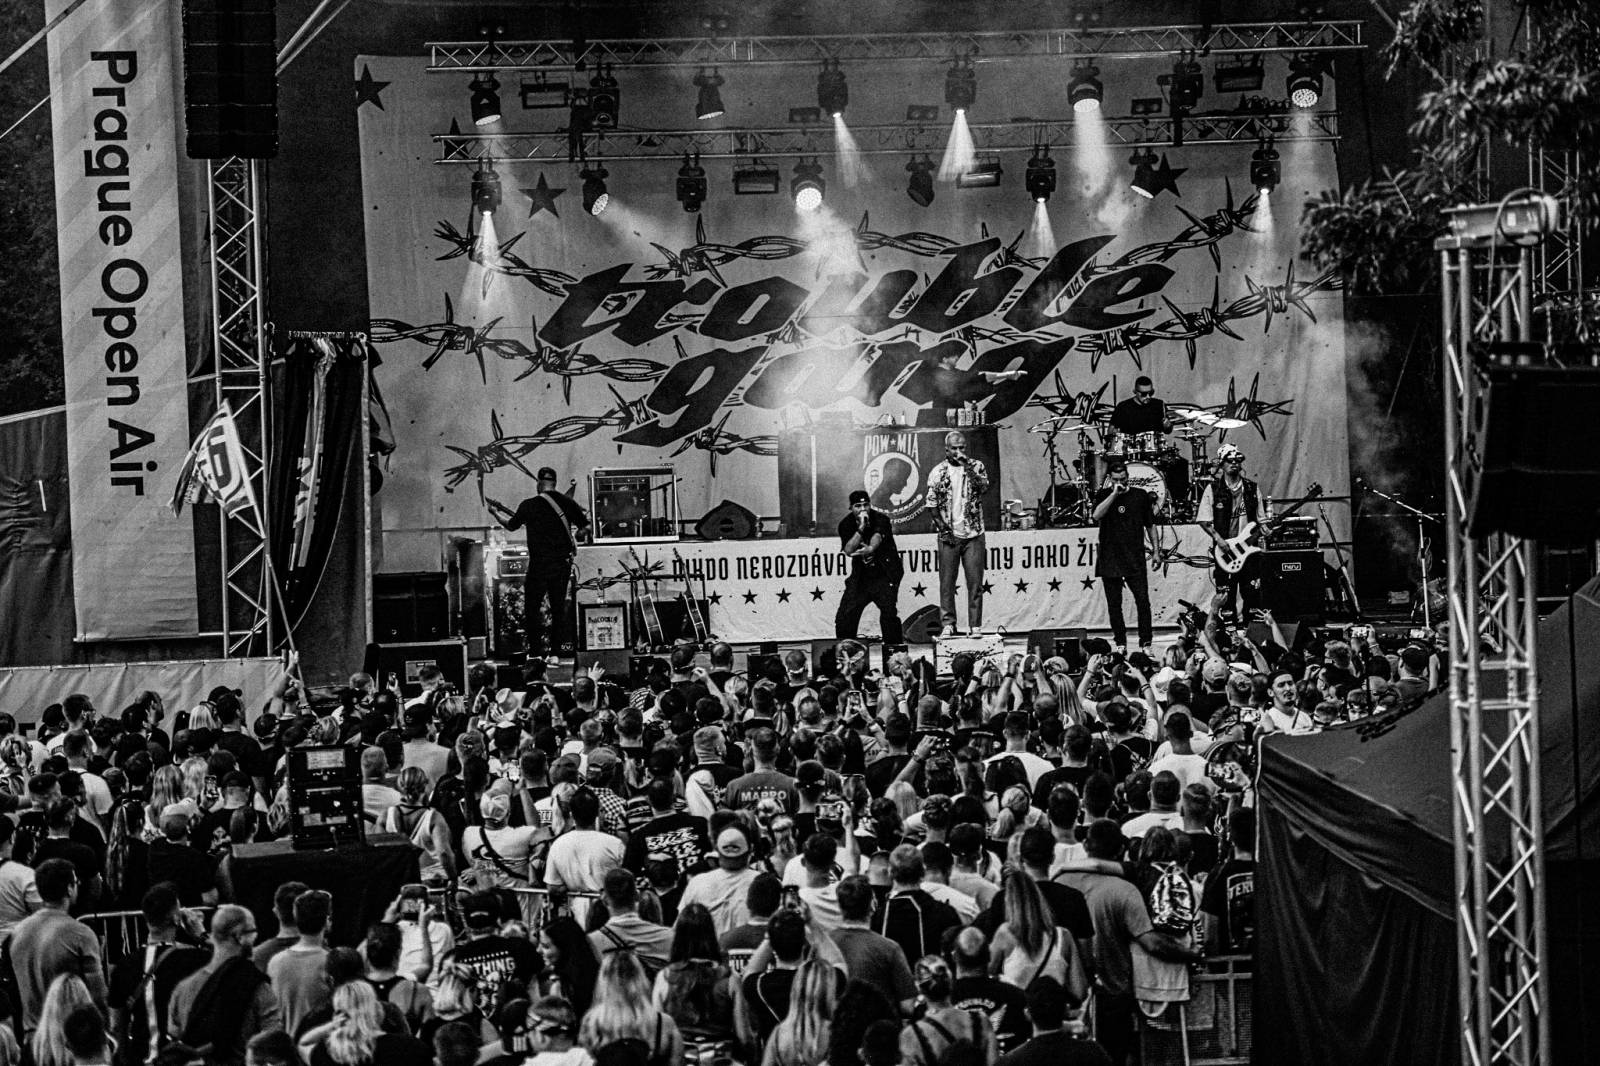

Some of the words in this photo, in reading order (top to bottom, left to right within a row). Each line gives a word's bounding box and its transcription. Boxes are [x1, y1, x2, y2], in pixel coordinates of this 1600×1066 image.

[84, 51, 138, 247] Prague
[91, 258, 149, 406] Open
[107, 418, 158, 496] Air
[863, 434, 890, 469] POW
[896, 433, 920, 468] MIA
[1022, 543, 1069, 568] JAKO
[1077, 537, 1099, 566] ŽI
